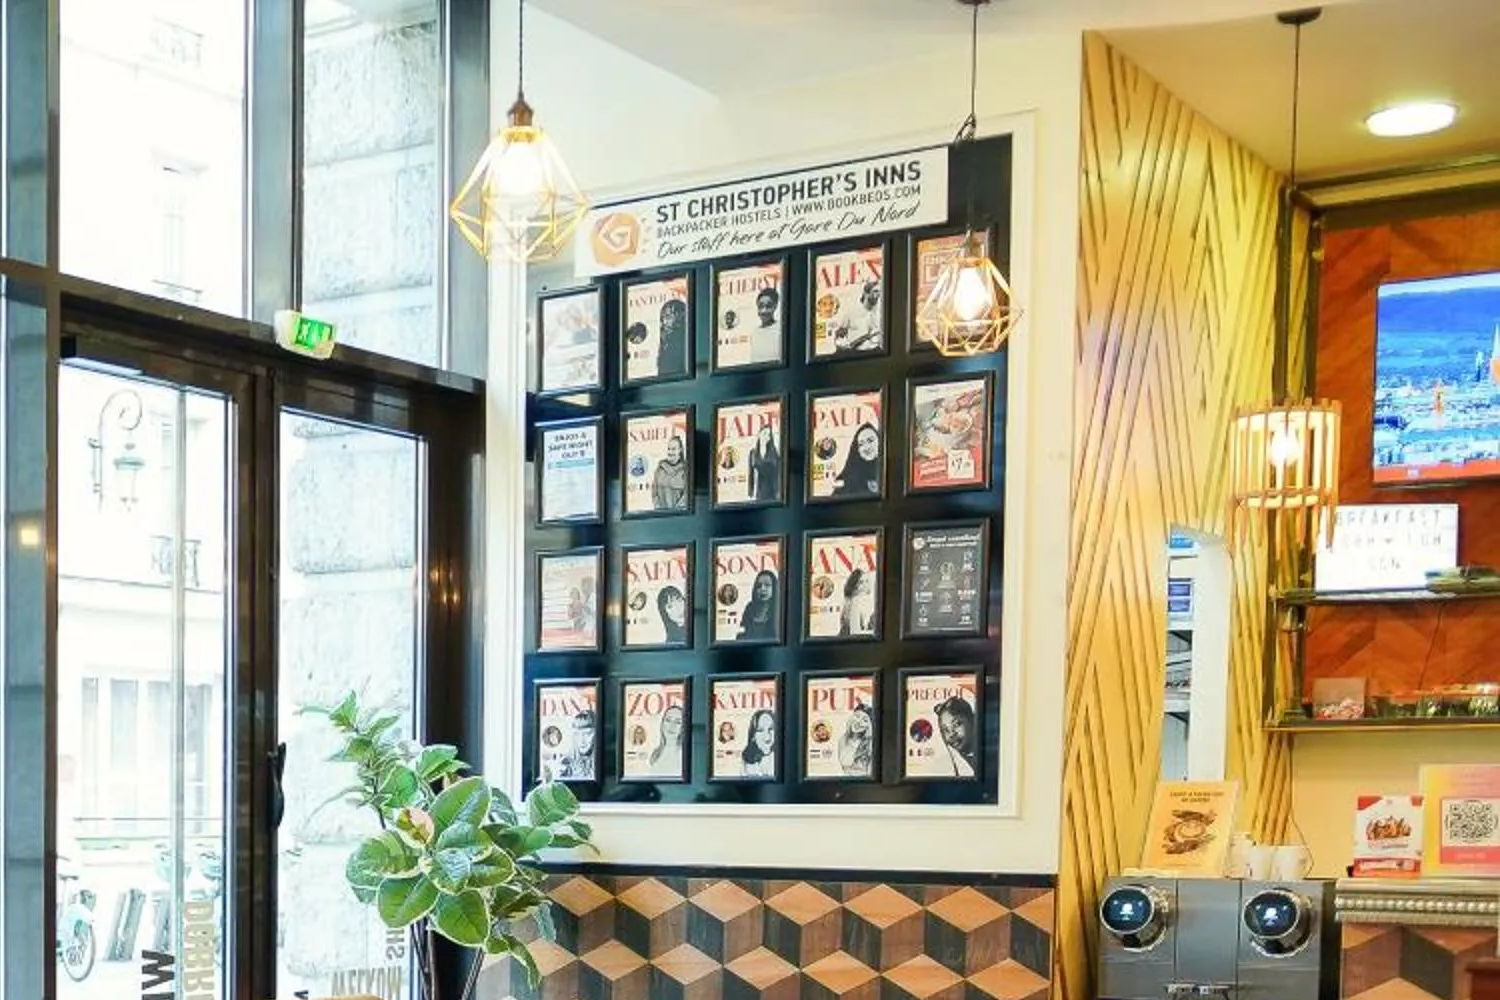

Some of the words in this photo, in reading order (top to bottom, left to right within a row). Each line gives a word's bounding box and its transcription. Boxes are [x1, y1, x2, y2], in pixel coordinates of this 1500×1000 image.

[656, 203, 681, 223] ST
[687, 171, 857, 219] CHRISTOPHER'S
[865, 160, 921, 188] INNS
[657, 214, 728, 239] BACKPACKER
[731, 206, 782, 226] HOSTELS
[657, 240, 685, 259] Our
[690, 231, 728, 254] staff
[730, 227, 765, 244] here
[767, 221, 789, 239] at
[789, 216, 834, 240] Gare
[836, 211, 866, 230] Du
[871, 200, 921, 228] Nord
[819, 257, 883, 289] ALEX
